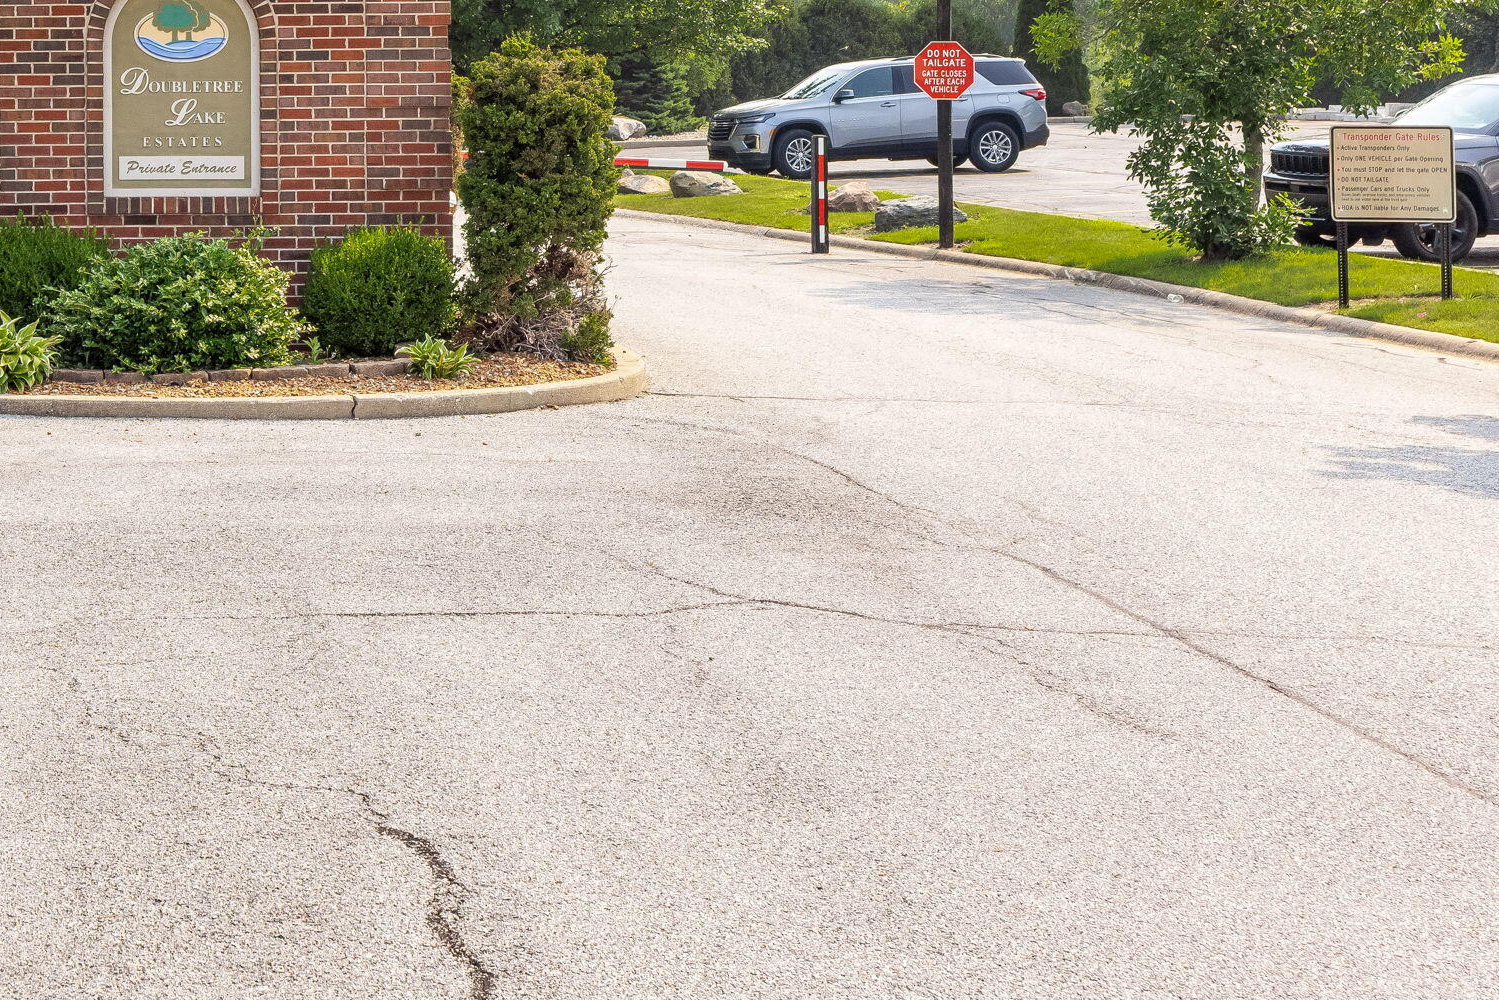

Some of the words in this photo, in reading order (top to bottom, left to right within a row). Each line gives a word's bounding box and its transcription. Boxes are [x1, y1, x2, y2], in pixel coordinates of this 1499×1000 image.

[927, 49, 940, 58] DO
[942, 49, 961, 58] NOT
[922, 58, 967, 67] TAILGATE
[120, 67, 243, 95] DOUBLETREE
[165, 98, 226, 127] LAKE
[142, 136, 223, 147] ESTATES
[1342, 132, 1392, 142] Transponder
[1395, 132, 1414, 141] Gate
[1417, 132, 1440, 141] Rules
[1359, 144, 1395, 152] Transponders
[1396, 144, 1411, 152] Only
[1419, 155, 1444, 163] Opening
[126, 160, 175, 175] Private
[180, 160, 237, 175] Entrance
